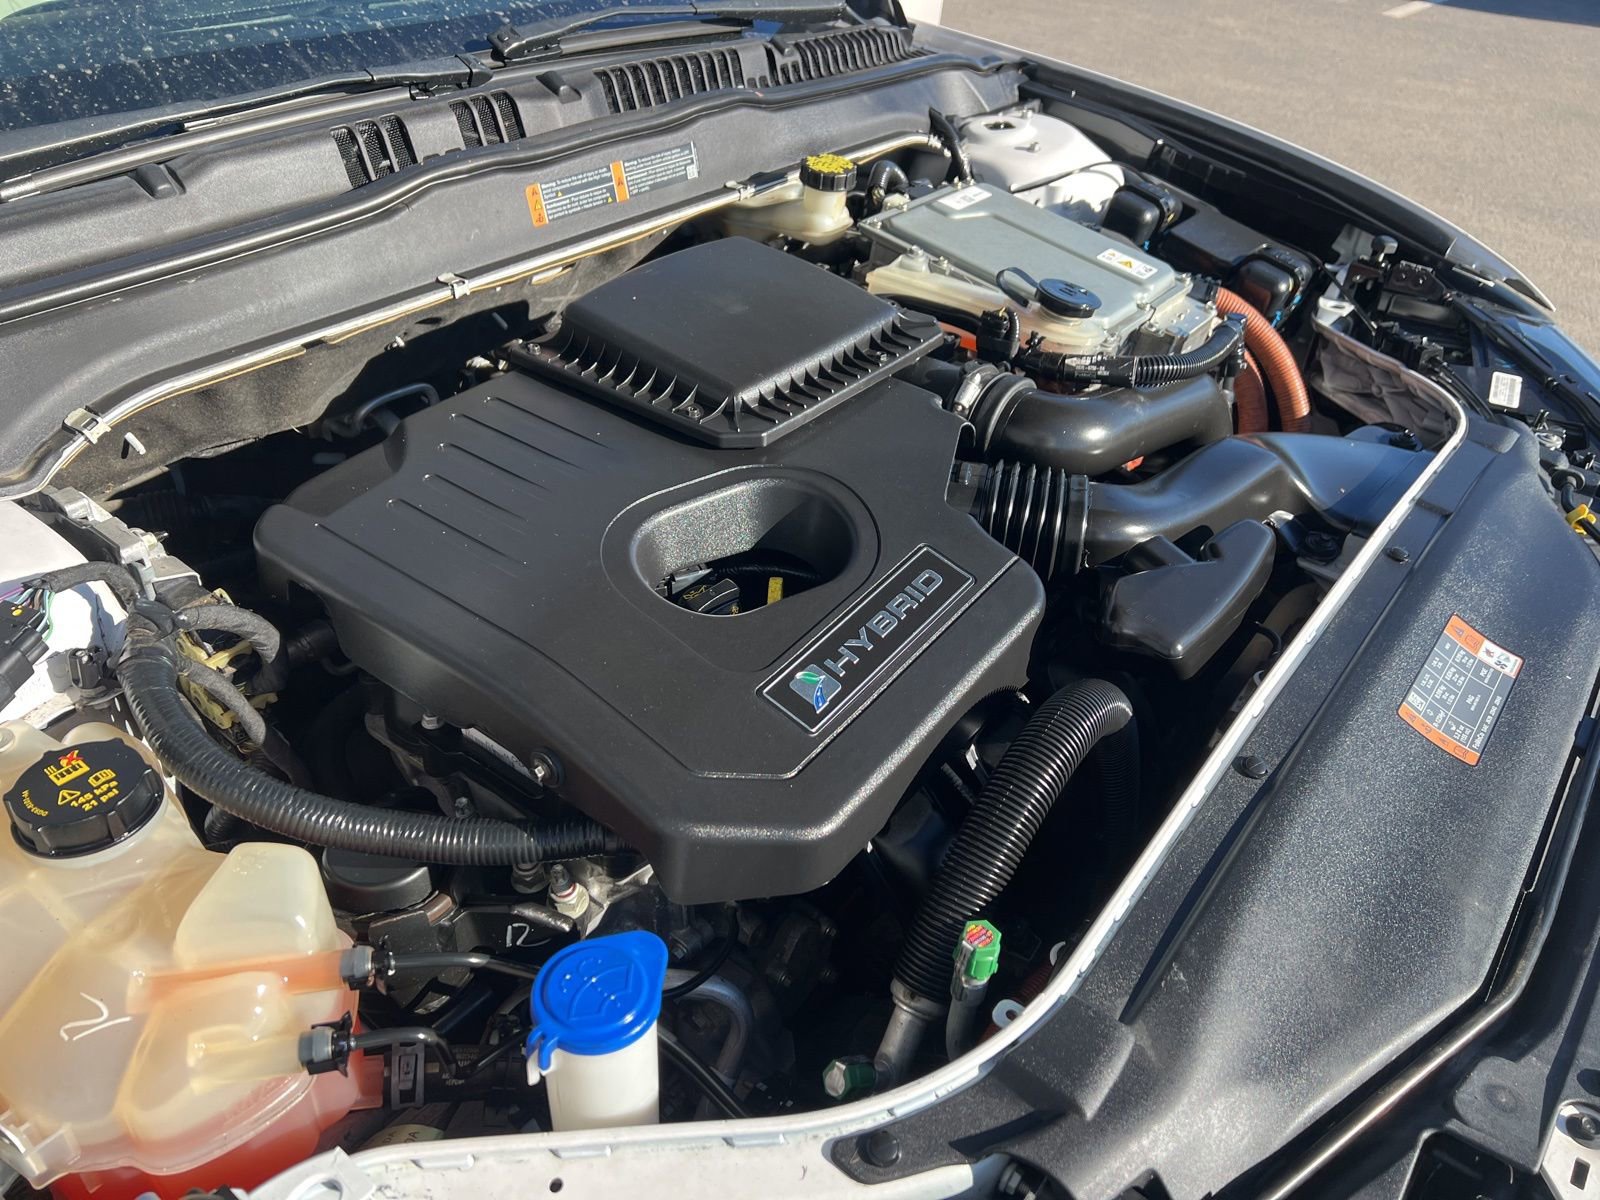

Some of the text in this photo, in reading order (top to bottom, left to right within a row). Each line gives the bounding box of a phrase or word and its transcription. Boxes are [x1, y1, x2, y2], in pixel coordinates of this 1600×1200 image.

[824, 569, 943, 677] HYBRID
[70, 780, 119, 808] 145 kPa
[82, 788, 119, 812] 21 psi
